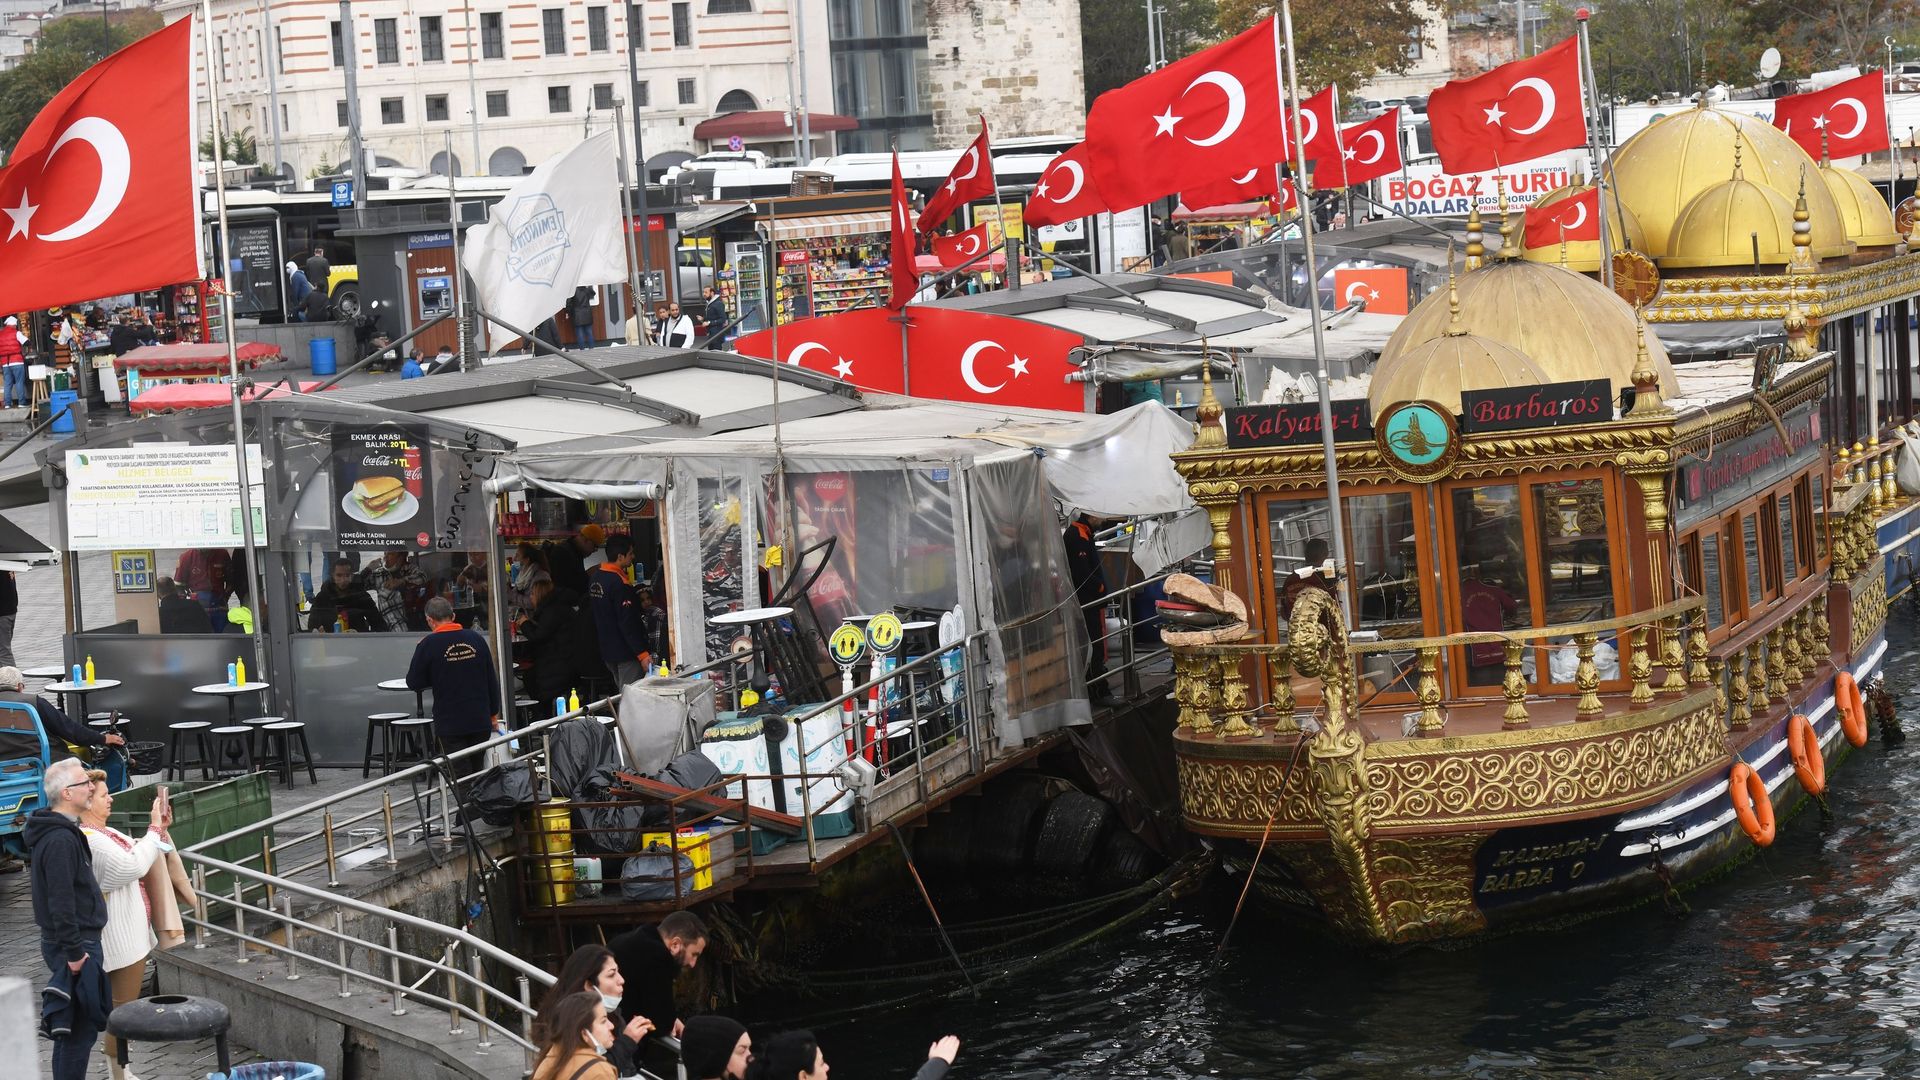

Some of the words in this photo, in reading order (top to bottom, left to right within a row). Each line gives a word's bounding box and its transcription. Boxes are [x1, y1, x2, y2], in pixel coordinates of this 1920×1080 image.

[1530, 166, 1567, 174] EVERYDAY
[1389, 173, 1484, 201] BOĞAZ
[1492, 171, 1568, 194] TURU
[1478, 194, 1538, 205] BOSHORUS
[1391, 198, 1469, 216] ADALAR
[1473, 394, 1600, 424] Barbaros
[399, 441, 409, 450] TL
[399, 458, 410, 467] TL
